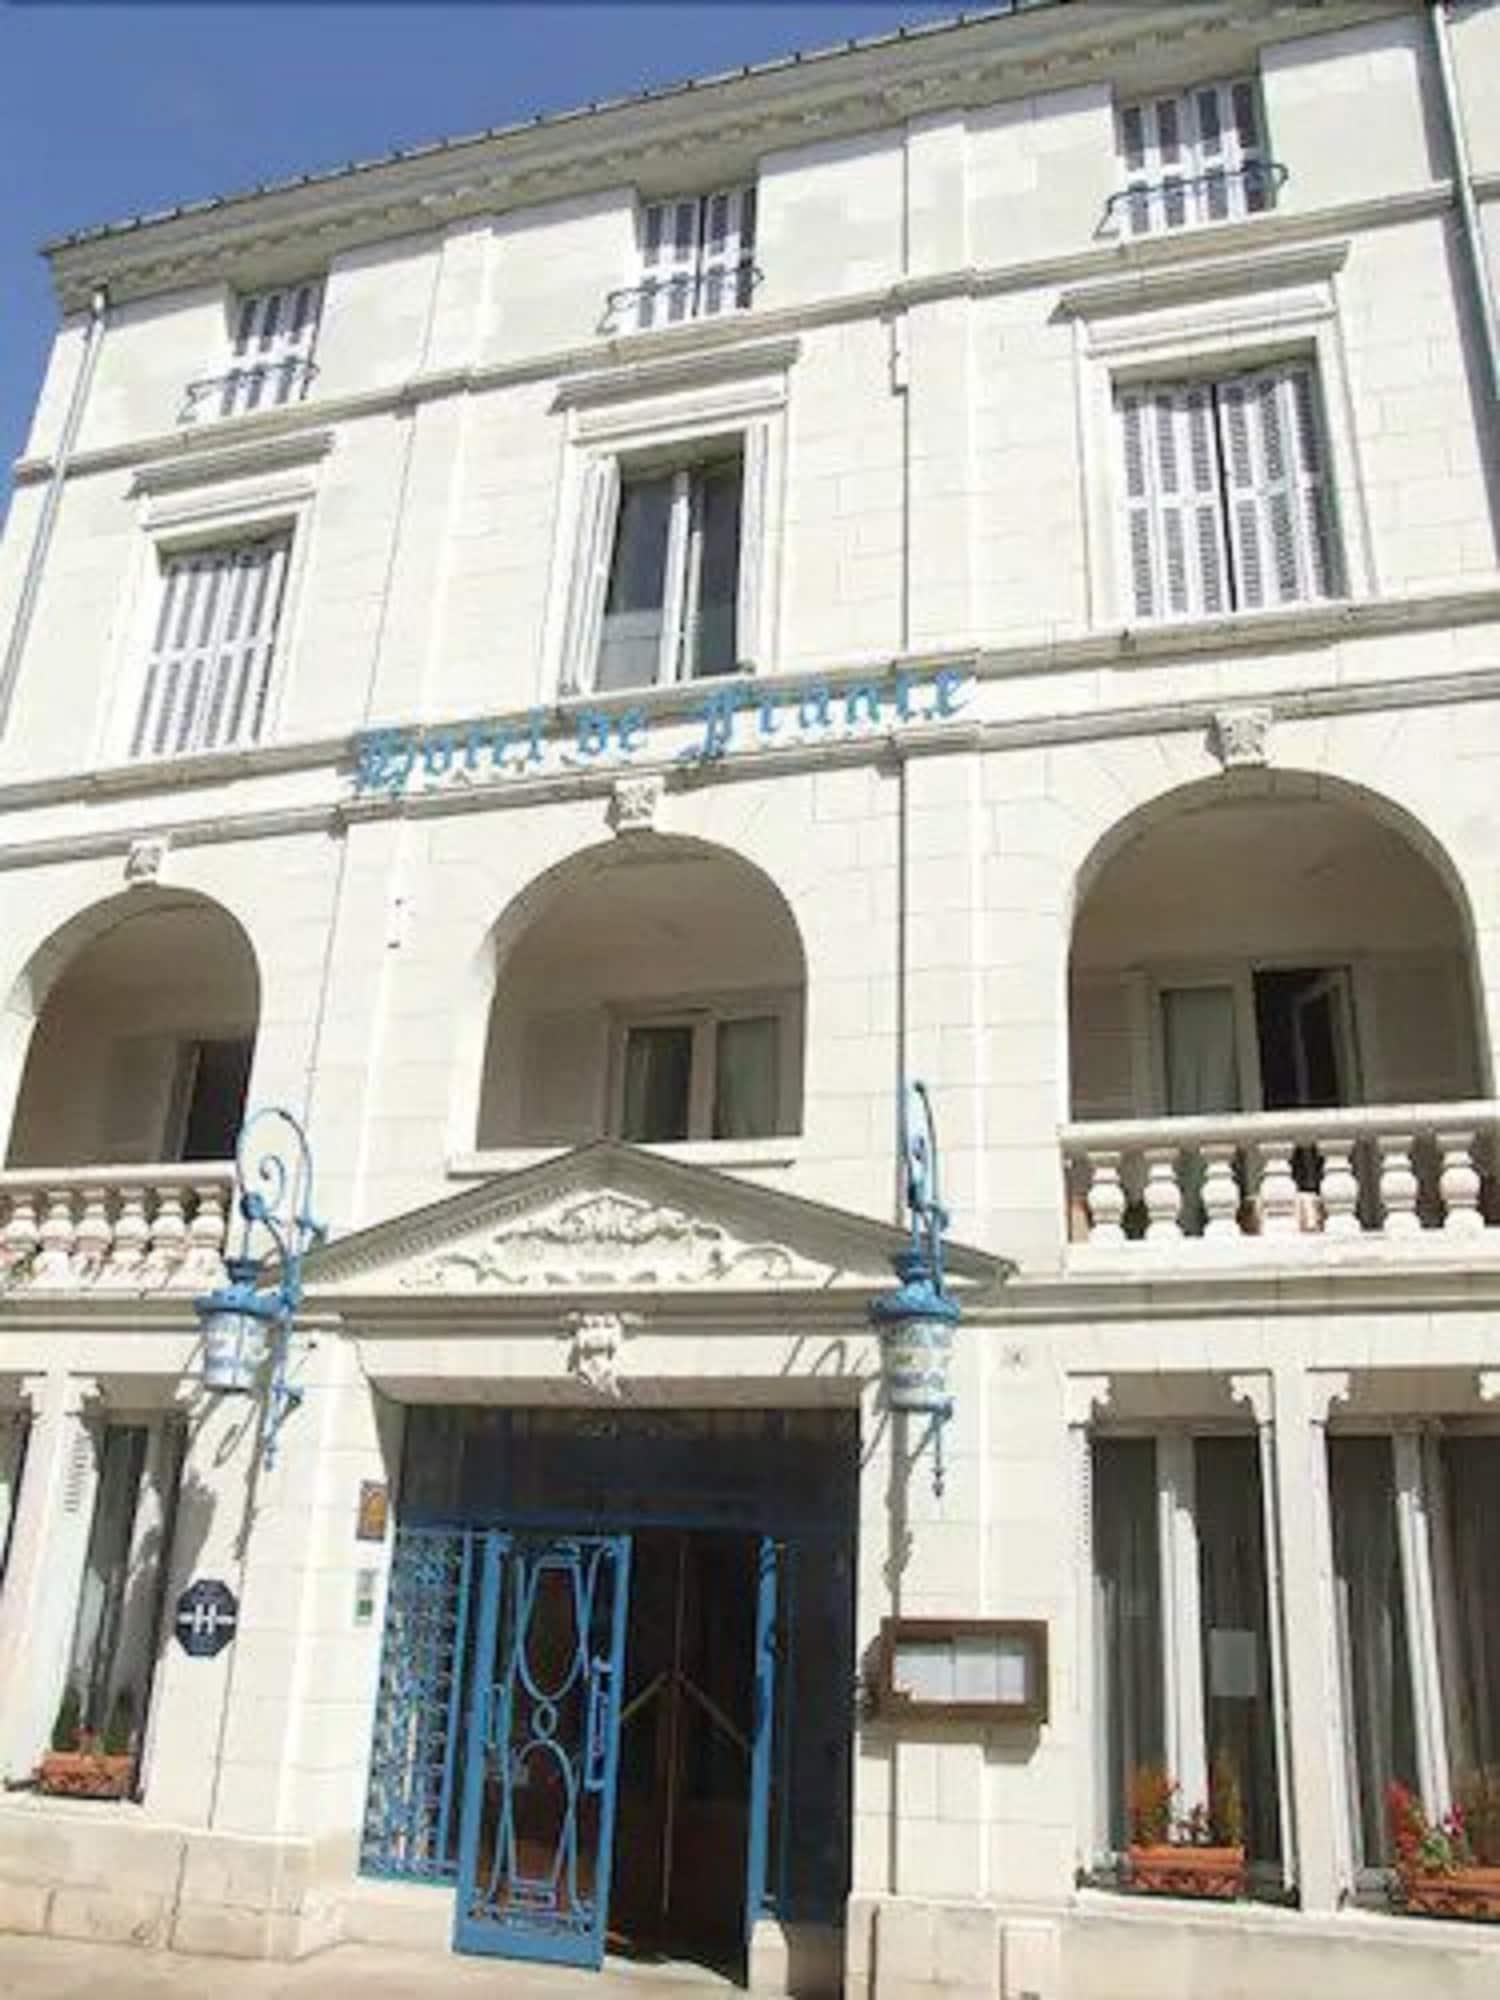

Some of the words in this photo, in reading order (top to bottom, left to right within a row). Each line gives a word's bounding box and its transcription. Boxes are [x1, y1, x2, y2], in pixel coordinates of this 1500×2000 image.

[576, 705, 648, 756] de
[675, 670, 967, 763] France
[193, 1604, 217, 1634] H
